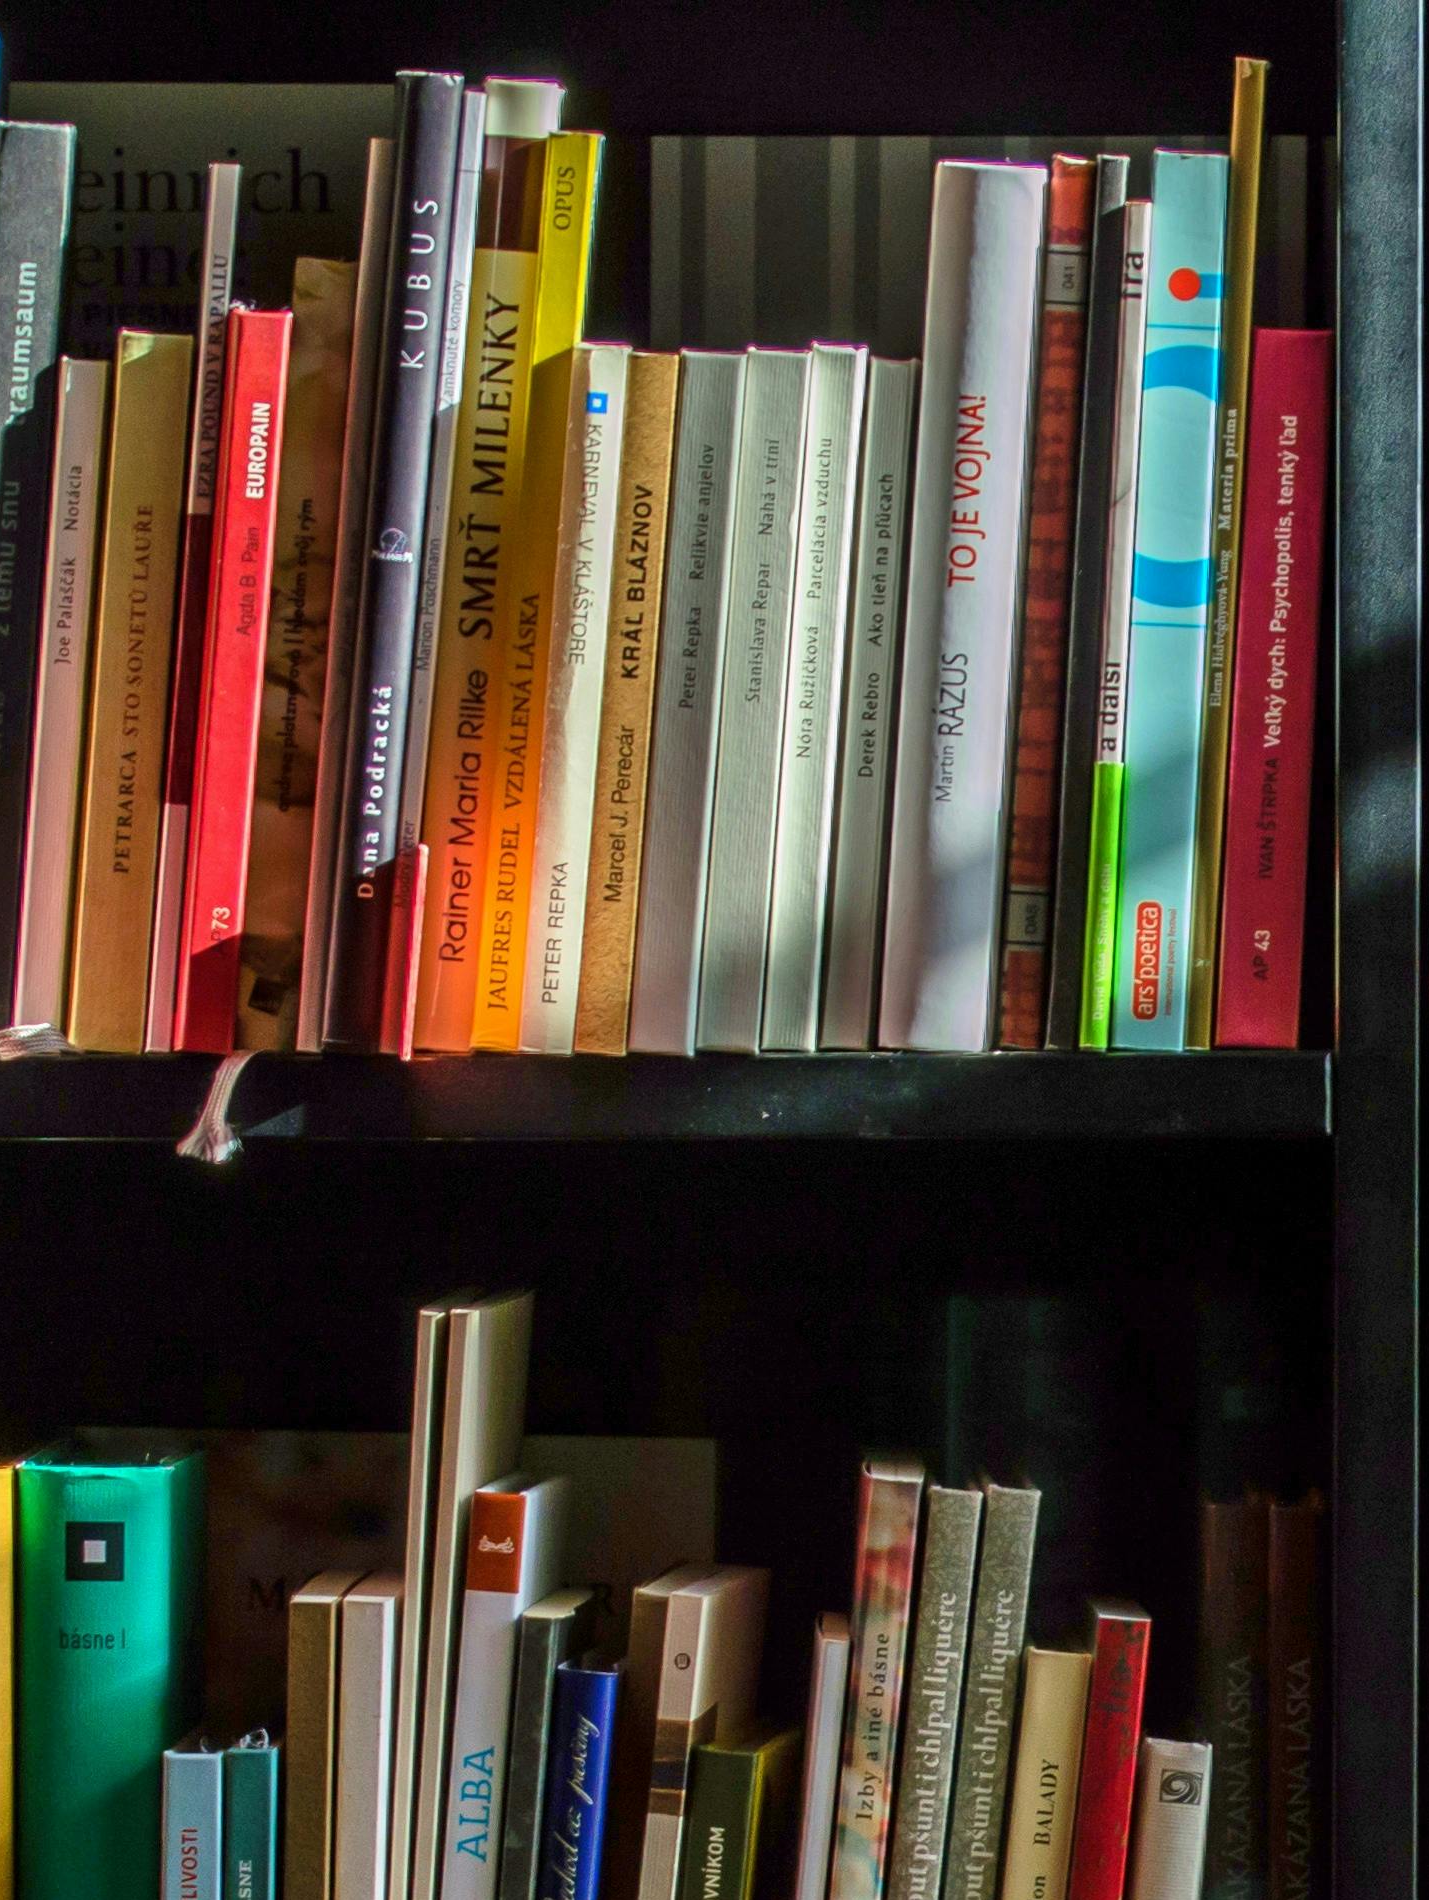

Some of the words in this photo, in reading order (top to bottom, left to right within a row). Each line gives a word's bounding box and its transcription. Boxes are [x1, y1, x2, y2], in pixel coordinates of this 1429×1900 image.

[552, 164, 576, 231] OPUS
[474, 291, 522, 496] MILENKY
[243, 401, 272, 498] EUROPAIN
[951, 393, 990, 501] VOJNA!
[945, 546, 976, 588] TO
[949, 507, 987, 539] JE
[456, 510, 505, 638] SMRŤ
[450, 668, 490, 745] Rilke
[443, 752, 480, 845] Maria
[437, 855, 474, 963] Rainer
[455, 1744, 495, 1861] ALBA
[1031, 1757, 1060, 1846] BALADY
